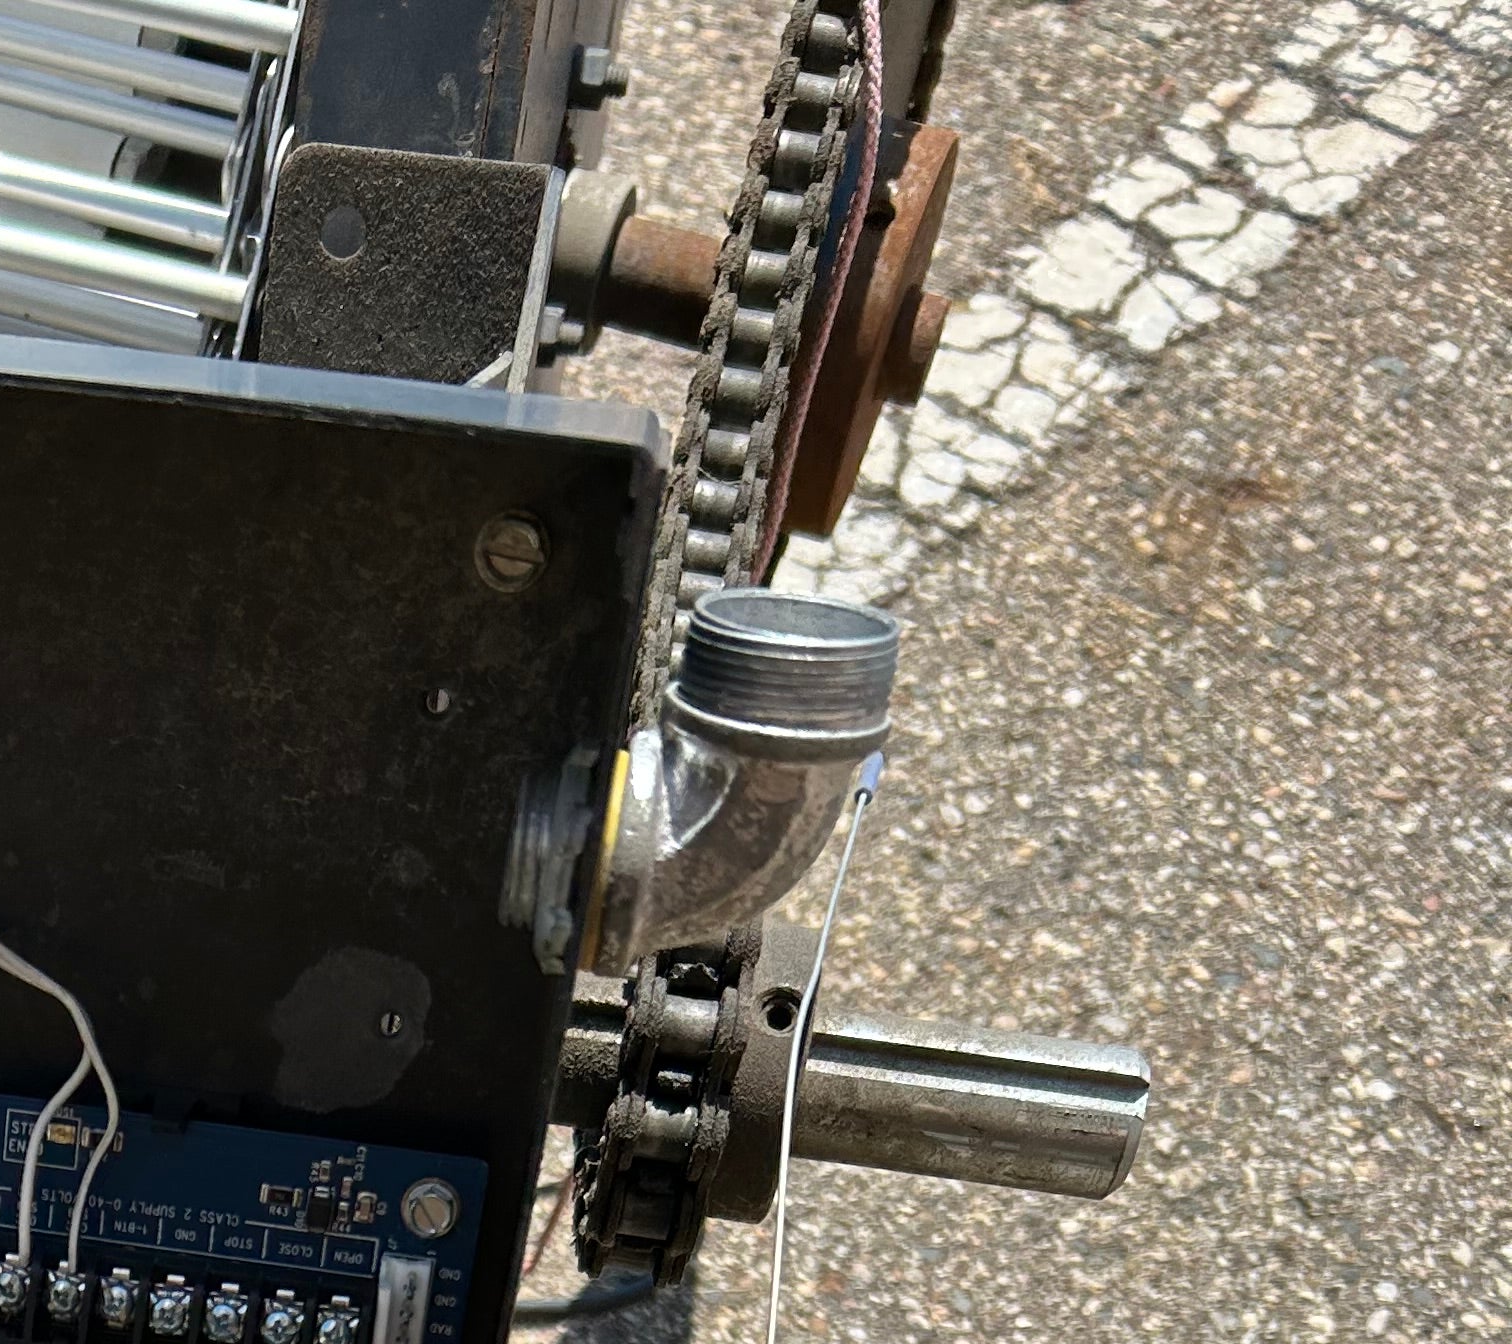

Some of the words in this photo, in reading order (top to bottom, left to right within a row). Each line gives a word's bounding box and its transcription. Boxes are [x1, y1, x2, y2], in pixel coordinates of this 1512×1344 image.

[128, 1202, 176, 1218] SUPPLY
[183, 1208, 192, 1220] 2
[199, 1210, 239, 1226] CLASS
[174, 1228, 196, 1242] GND
[224, 1236, 253, 1250] STOP
[278, 1243, 313, 1258] CLOSE
[334, 1251, 363, 1266] OPEN
[439, 1268, 461, 1281] GND
[434, 1295, 457, 1307] GND
